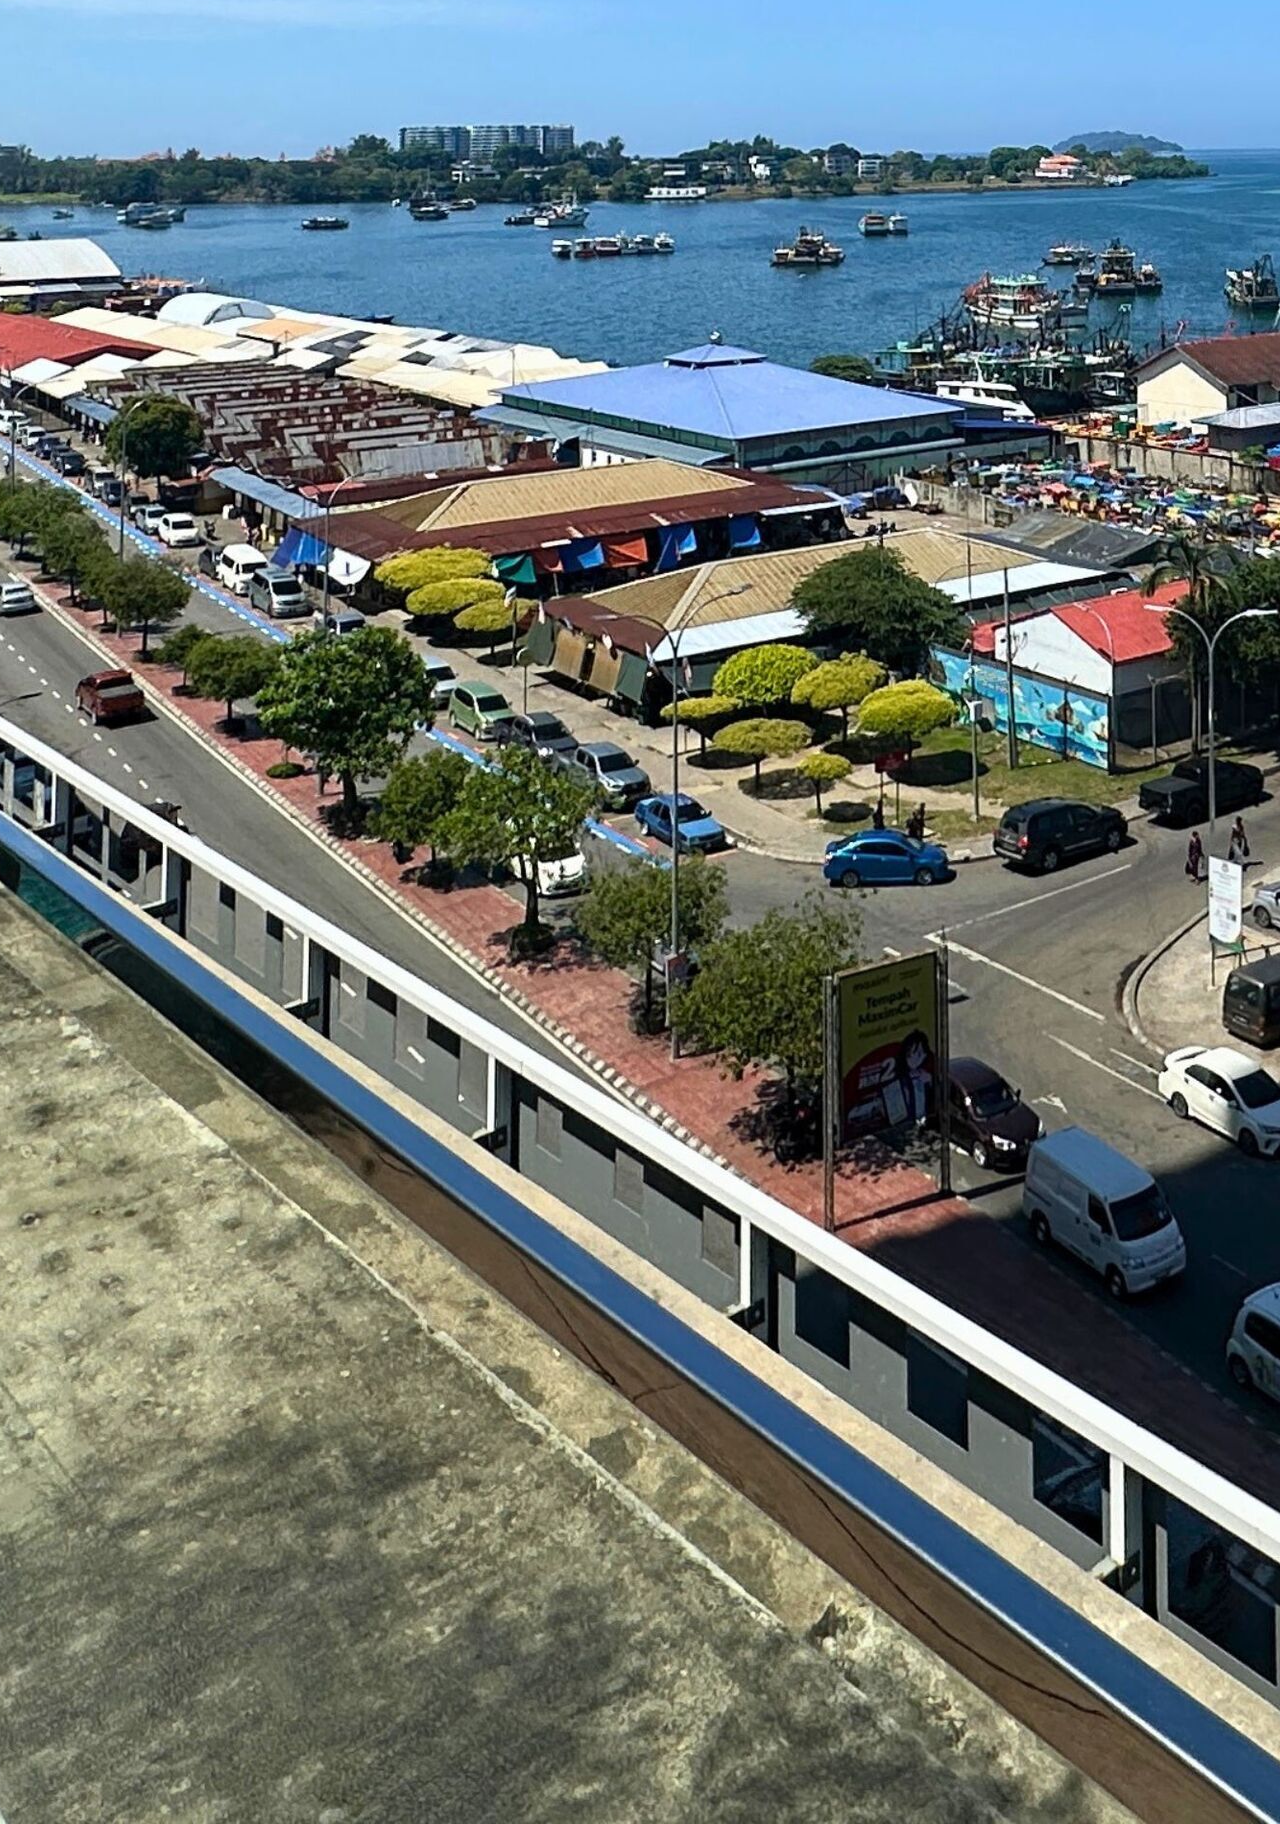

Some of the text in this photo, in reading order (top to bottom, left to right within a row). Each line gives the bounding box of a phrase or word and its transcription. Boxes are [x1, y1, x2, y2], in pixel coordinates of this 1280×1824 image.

[866, 986, 911, 1008] Tempah
[858, 1001, 919, 1027] MaximCar
[881, 1057, 896, 1082] 2
